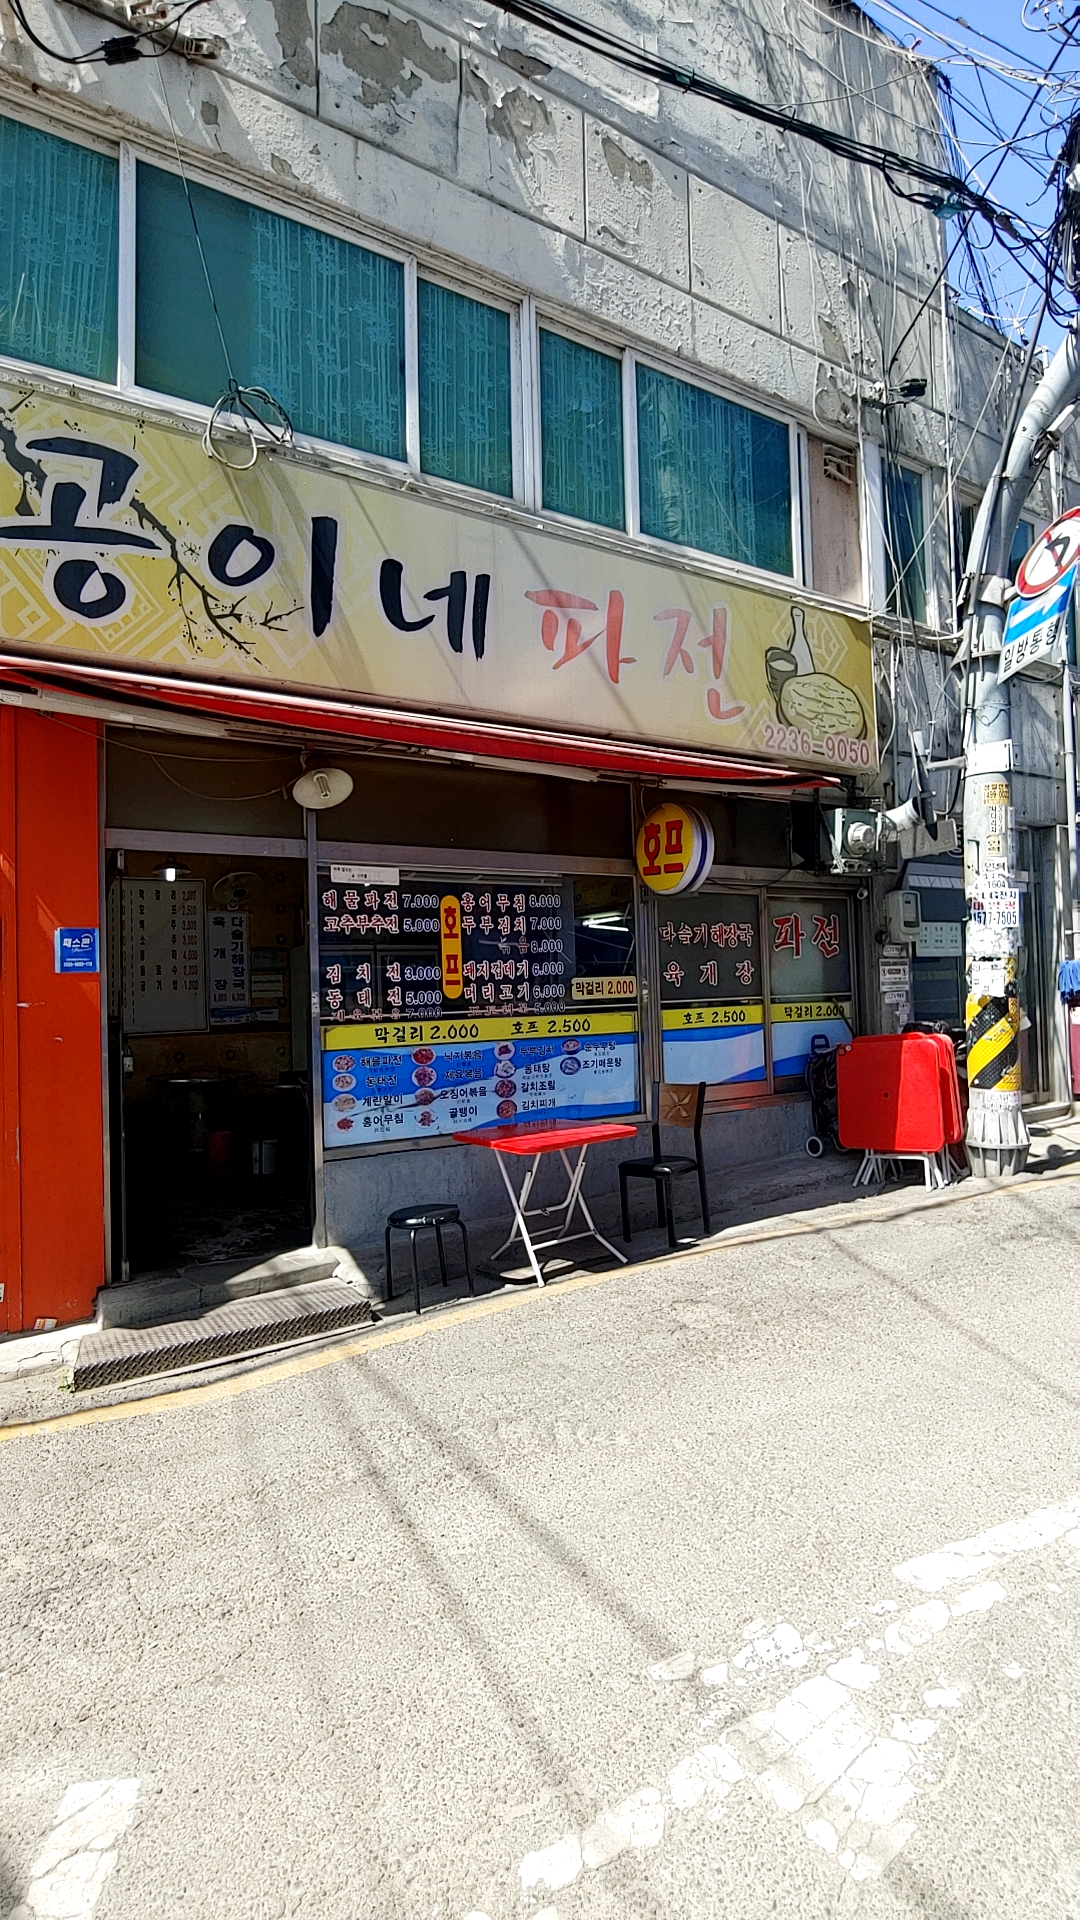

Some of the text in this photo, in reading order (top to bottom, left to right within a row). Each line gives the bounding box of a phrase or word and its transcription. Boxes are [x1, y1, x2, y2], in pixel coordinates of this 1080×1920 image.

[1004, 616, 1061, 673] 일방통행
[524, 589, 746, 720] 파전
[763, 725, 870, 767] 2236-9050
[643, 819, 684, 876] 호프
[322, 889, 399, 910] 해물파전
[461, 892, 525, 913] 홍어무침
[323, 914, 400, 935] 고추부추전
[462, 915, 526, 935] 두부김치
[973, 911, 1017, 925] 1577-7505
[773, 913, 840, 959] 파전
[231, 916, 246, 990] 다슬기해장국
[443, 905, 460, 986] 호프
[463, 960, 529, 980] 돼지껍데기
[464, 982, 530, 1003] 머리고기
[575, 980, 604, 996] 막걸리
[607, 980, 634, 995] 2.000
[683, 1011, 705, 1025] 호프
[784, 1005, 813, 1019] 막걸리
[374, 1025, 423, 1043] 막걸리
[510, 1021, 539, 1035] 호프
[360, 1054, 402, 1068] 해물파전
[444, 1049, 483, 1062] 낙지볶음
[582, 1057, 622, 1069] 조기매운탕
[524, 1063, 550, 1075] 동태탕
[440, 1086, 488, 1100] 오징어볶음
[520, 1080, 556, 1093] 갈치조림
[362, 1094, 403, 1108] 계란말이
[521, 1098, 556, 1111] 김치찌개
[362, 1113, 404, 1129] 홍어무침
[448, 1105, 478, 1119] 골뱅이
